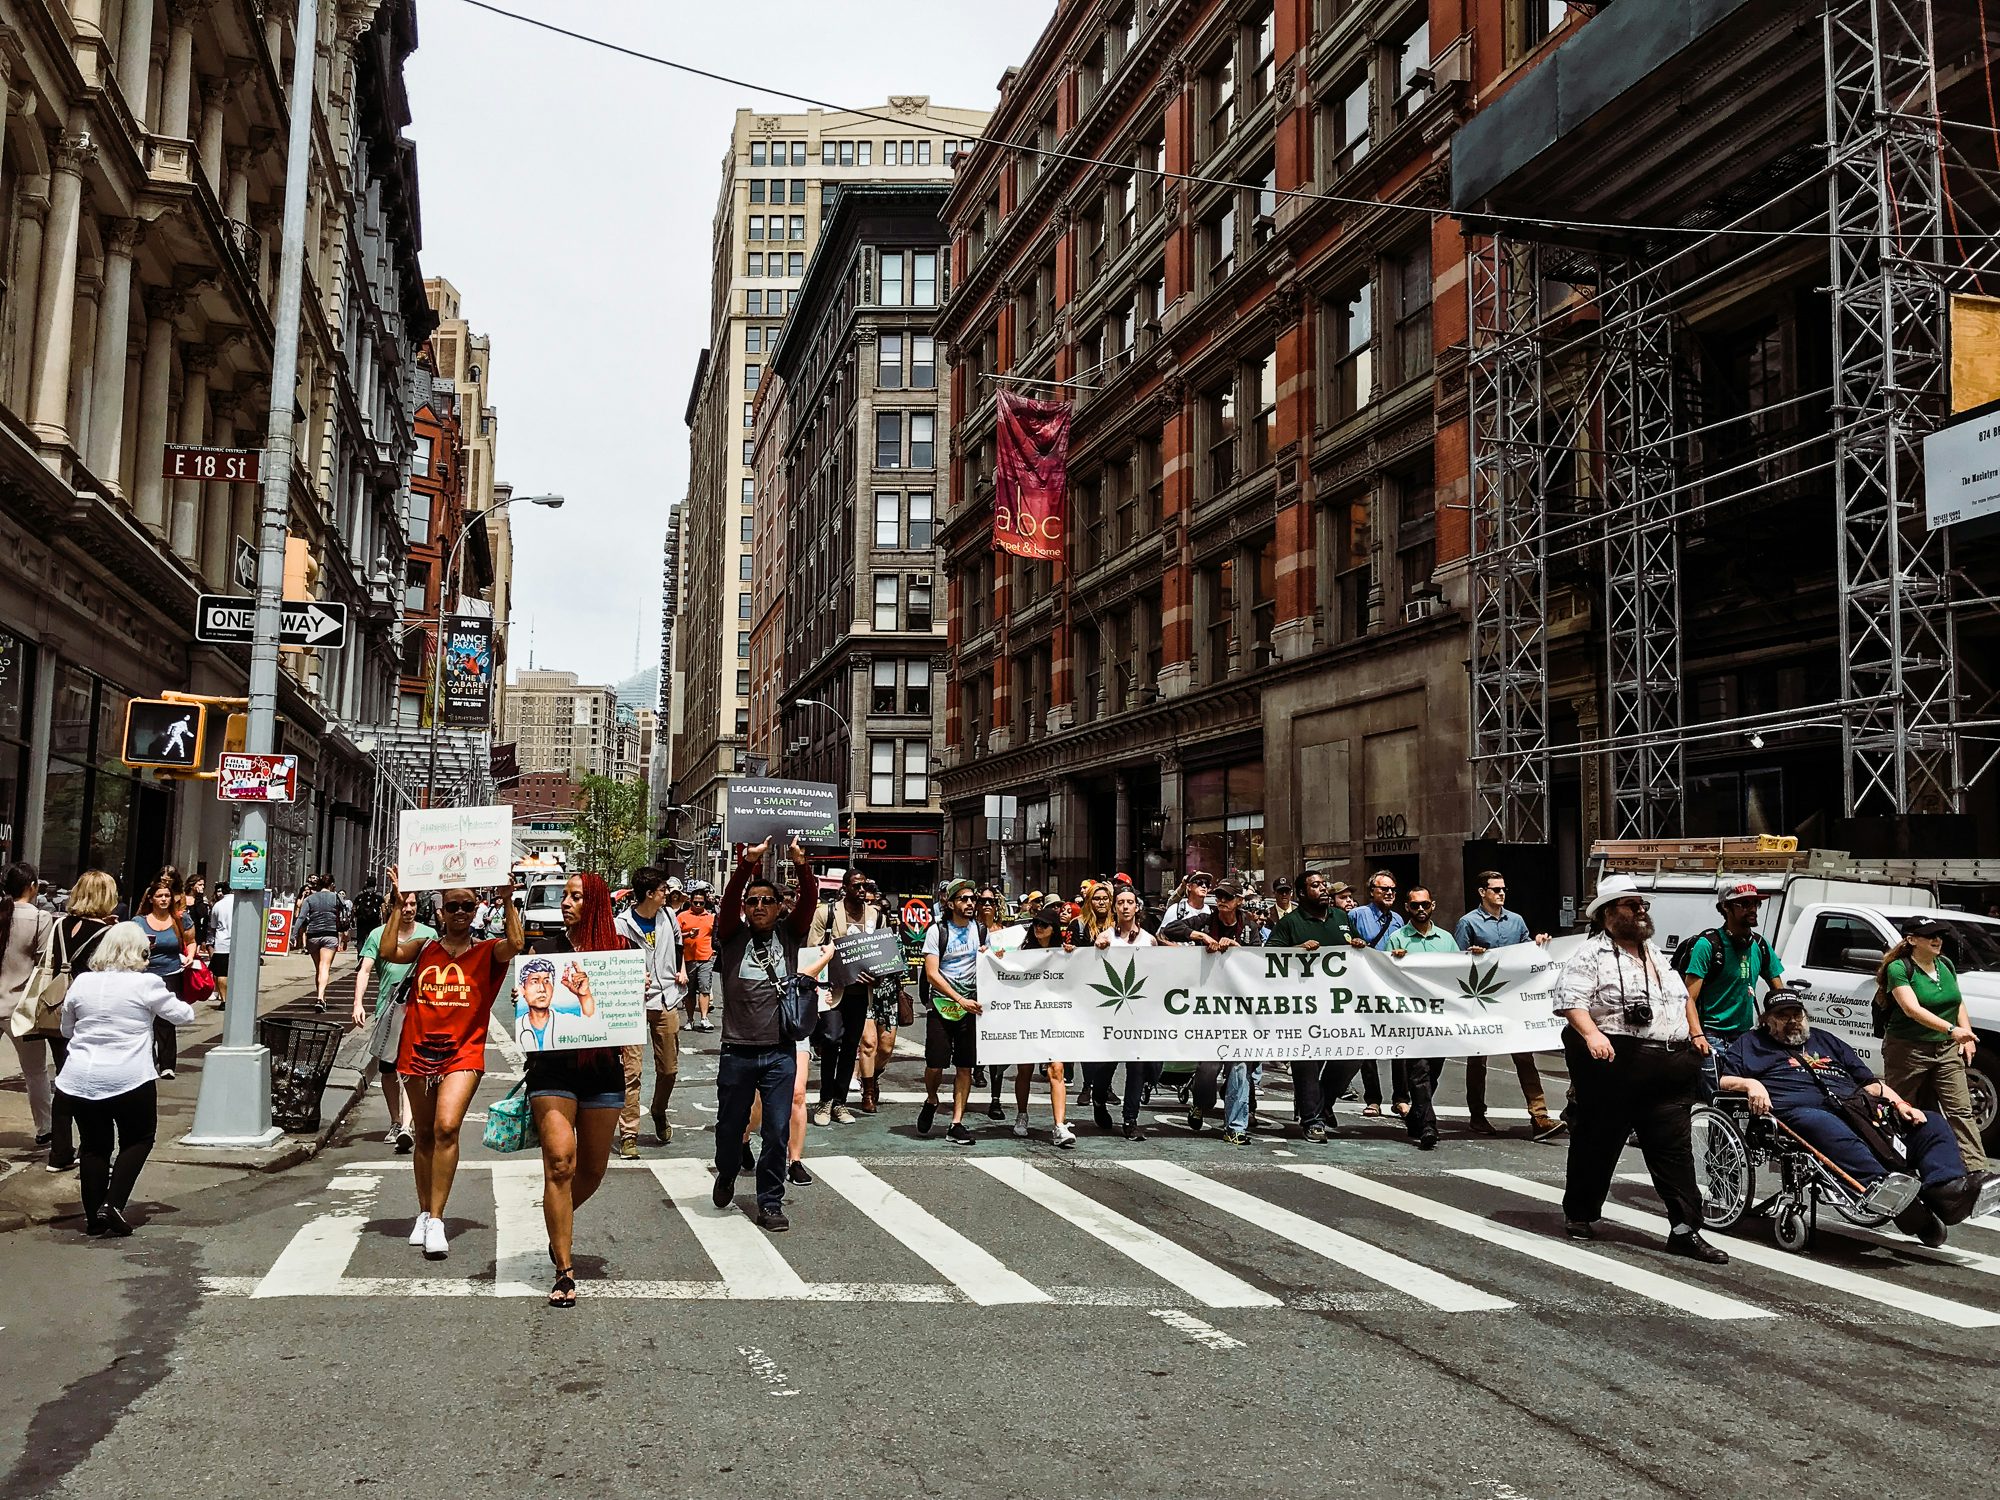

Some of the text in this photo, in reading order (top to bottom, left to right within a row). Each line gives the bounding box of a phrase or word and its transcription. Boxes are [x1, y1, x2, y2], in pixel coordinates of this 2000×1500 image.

[1979, 430, 1990, 442] 874
[175, 454, 246, 478] E 18 St
[1962, 477, 1970, 486] The
[996, 486, 1061, 540] abc
[1022, 542, 1032, 554] &
[1034, 544, 1061, 556] home
[212, 610, 325, 632] ONE WAY
[461, 620, 480, 628] NYC
[453, 633, 488, 643] DANCE
[447, 680, 489, 689] CABARET
[732, 786, 834, 798] LEGALIZING MARIJUANA
[764, 797, 797, 806] SMART
[777, 808, 831, 818] Communities
[1377, 814, 1406, 839] 880
[863, 839, 887, 849] mc
[1372, 842, 1412, 852] BROADWAY
[901, 908, 932, 922] TAXES
[914, 923, 919, 934] 4
[858, 933, 893, 944] MARIJUANA
[847, 944, 870, 956] SMART
[842, 951, 882, 964] Racial Justice
[583, 958, 606, 970] Every
[610, 957, 617, 965] 19
[1265, 952, 1348, 978] NYC
[1530, 964, 1546, 974] END
[588, 969, 625, 980] somebody
[997, 971, 1020, 980] HEAL
[1043, 970, 1064, 980] SICK
[422, 983, 470, 994] Marijuana
[592, 989, 607, 999] drug
[1163, 987, 1445, 1015] CANNABIS PARADE
[1520, 992, 1546, 1001] UNITE
[1819, 993, 1825, 1001] &
[1826, 993, 1870, 1007] Maintenance
[597, 1000, 613, 1008] that
[990, 1000, 1072, 1010] STOP THE ARRESTS
[602, 1012, 625, 1020] happen
[1524, 1020, 1547, 1030] FREE
[981, 1029, 1084, 1040] RELEASE THE MEDICINE
[1103, 1023, 1503, 1040] FOUNDING CHAPTER OF THE GLOBAL MARIJUANA MARCH
